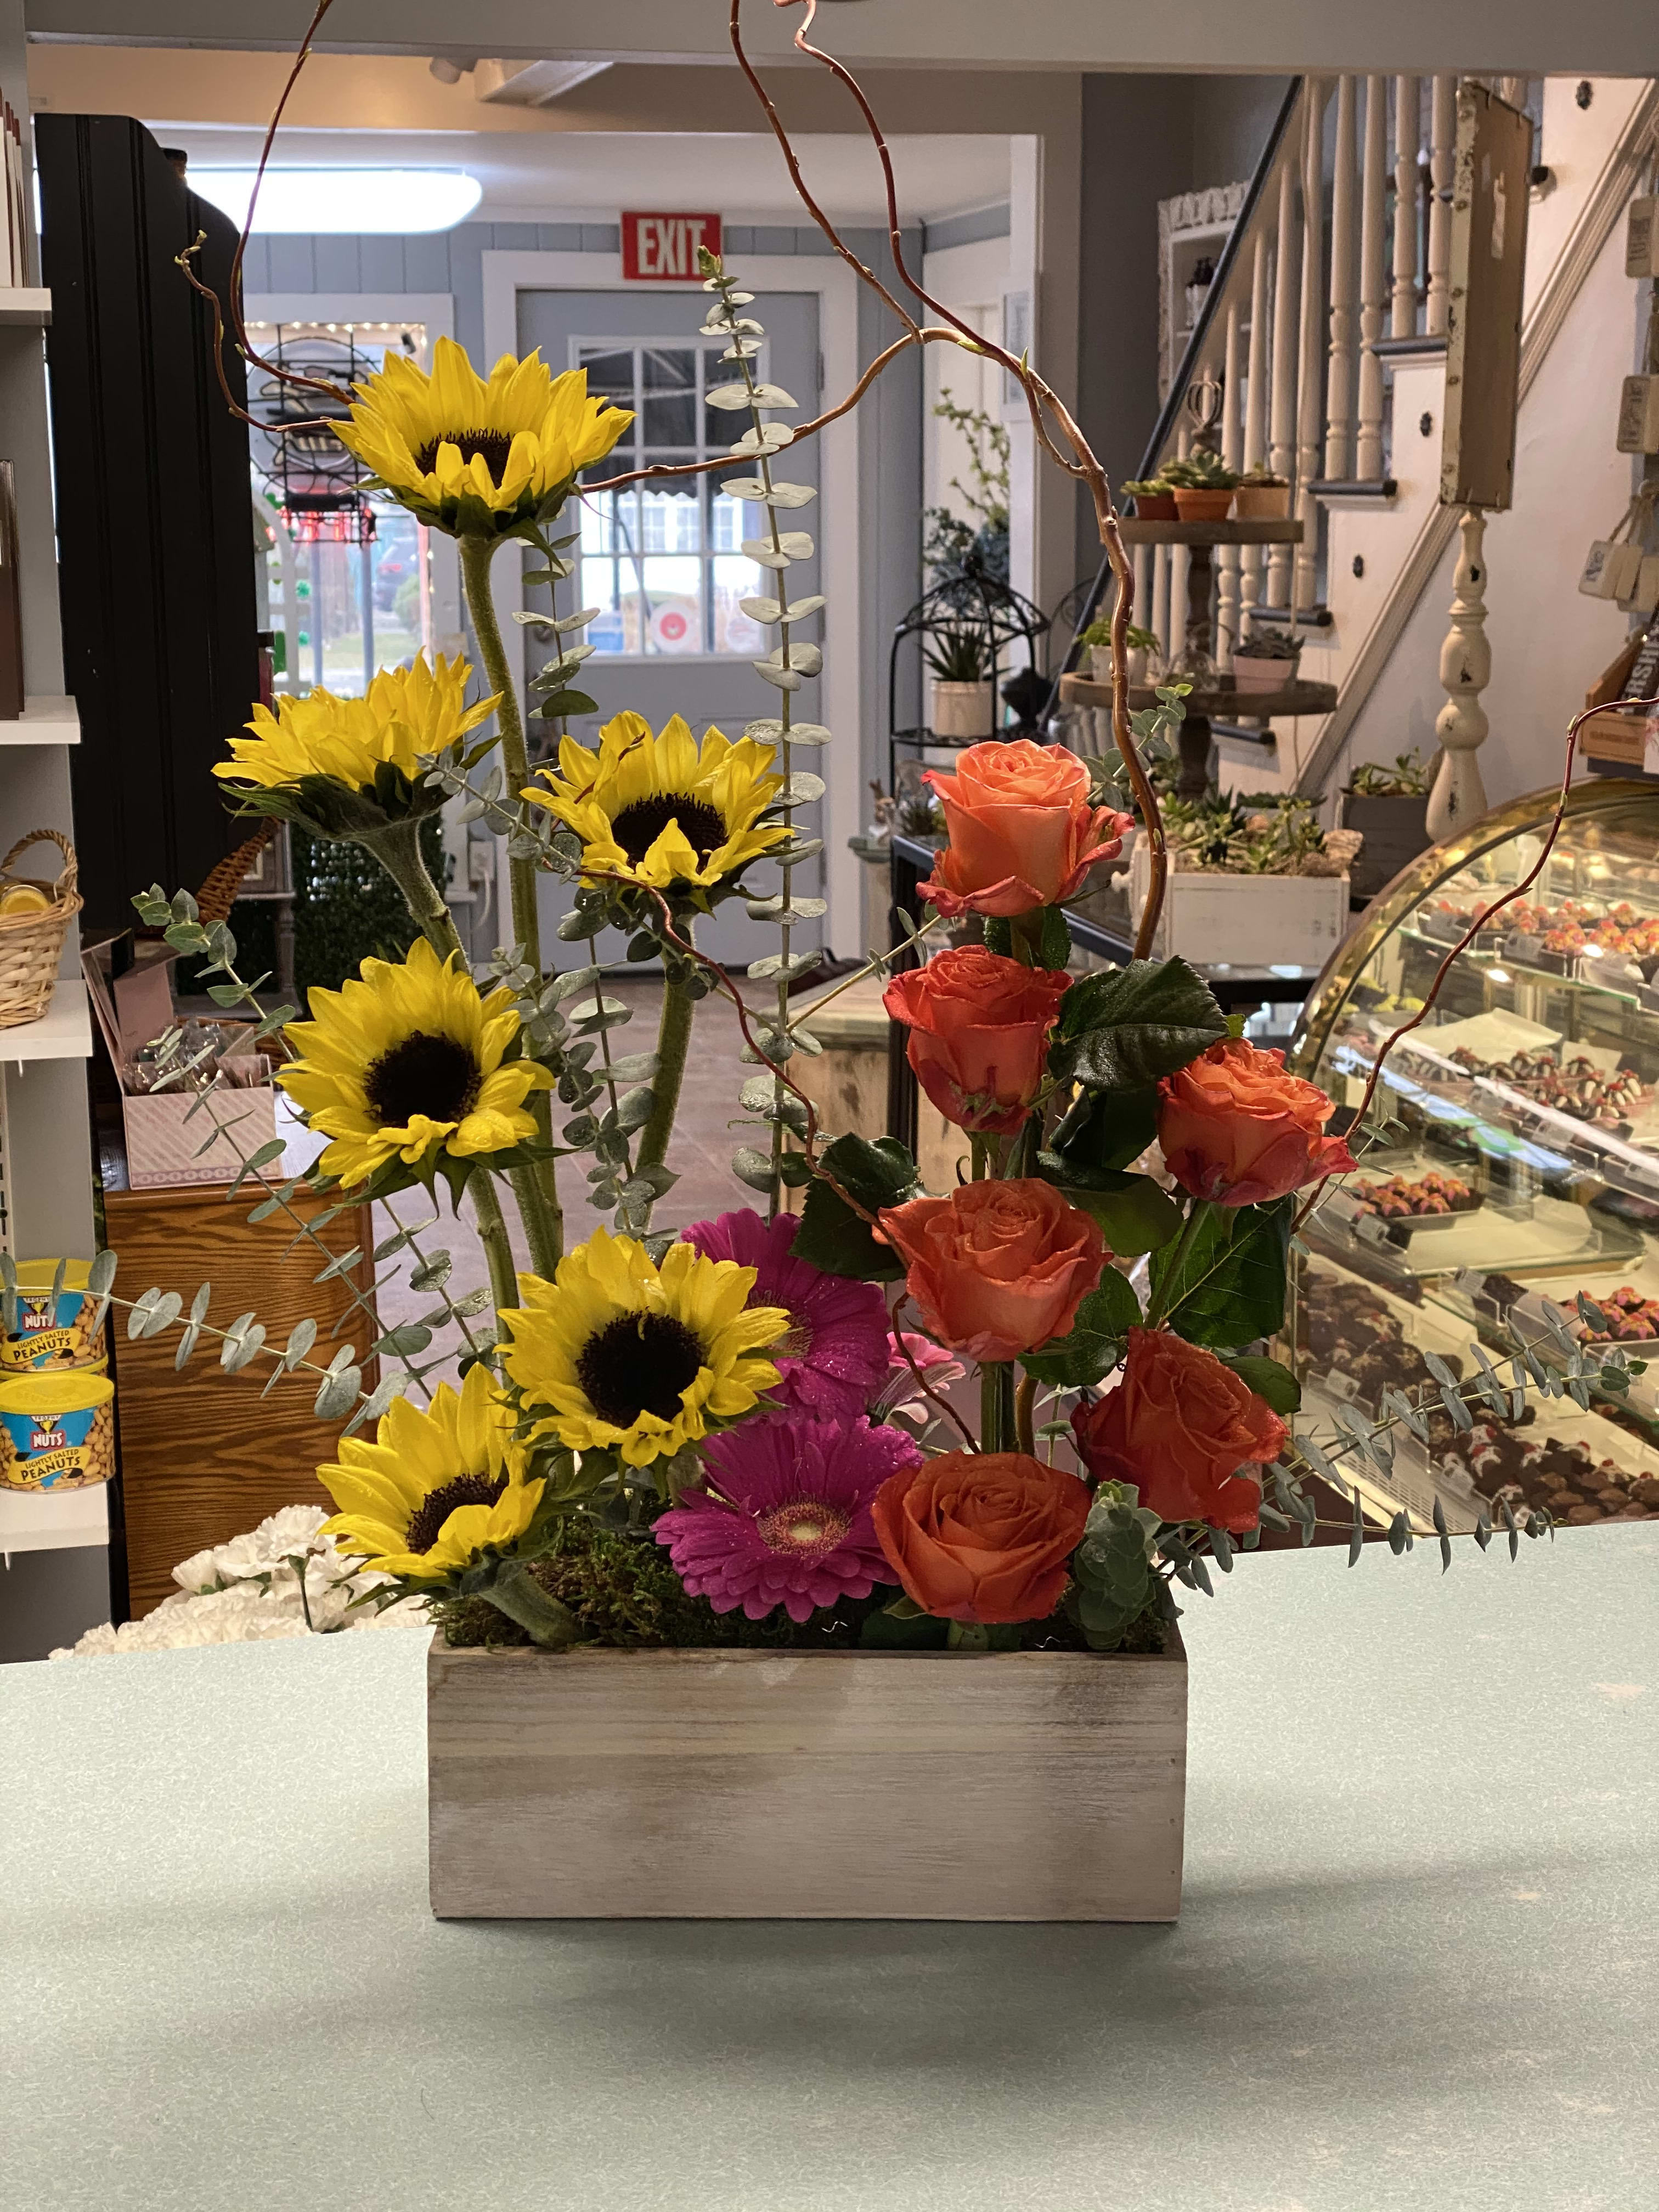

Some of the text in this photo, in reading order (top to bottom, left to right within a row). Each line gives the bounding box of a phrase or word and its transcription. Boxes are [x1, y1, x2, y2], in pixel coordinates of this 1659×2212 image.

[637, 219, 707, 275] EXIT
[25, 1315, 54, 1328] NUT
[13, 1338, 71, 1361] PEANUTS
[17, 1330, 69, 1349] LIGHTLY SALTED
[33, 1432, 63, 1448] NUTS
[20, 1456, 81, 1481] PEANUTS
[25, 1449, 79, 1469] LIGHTLY SALTED
